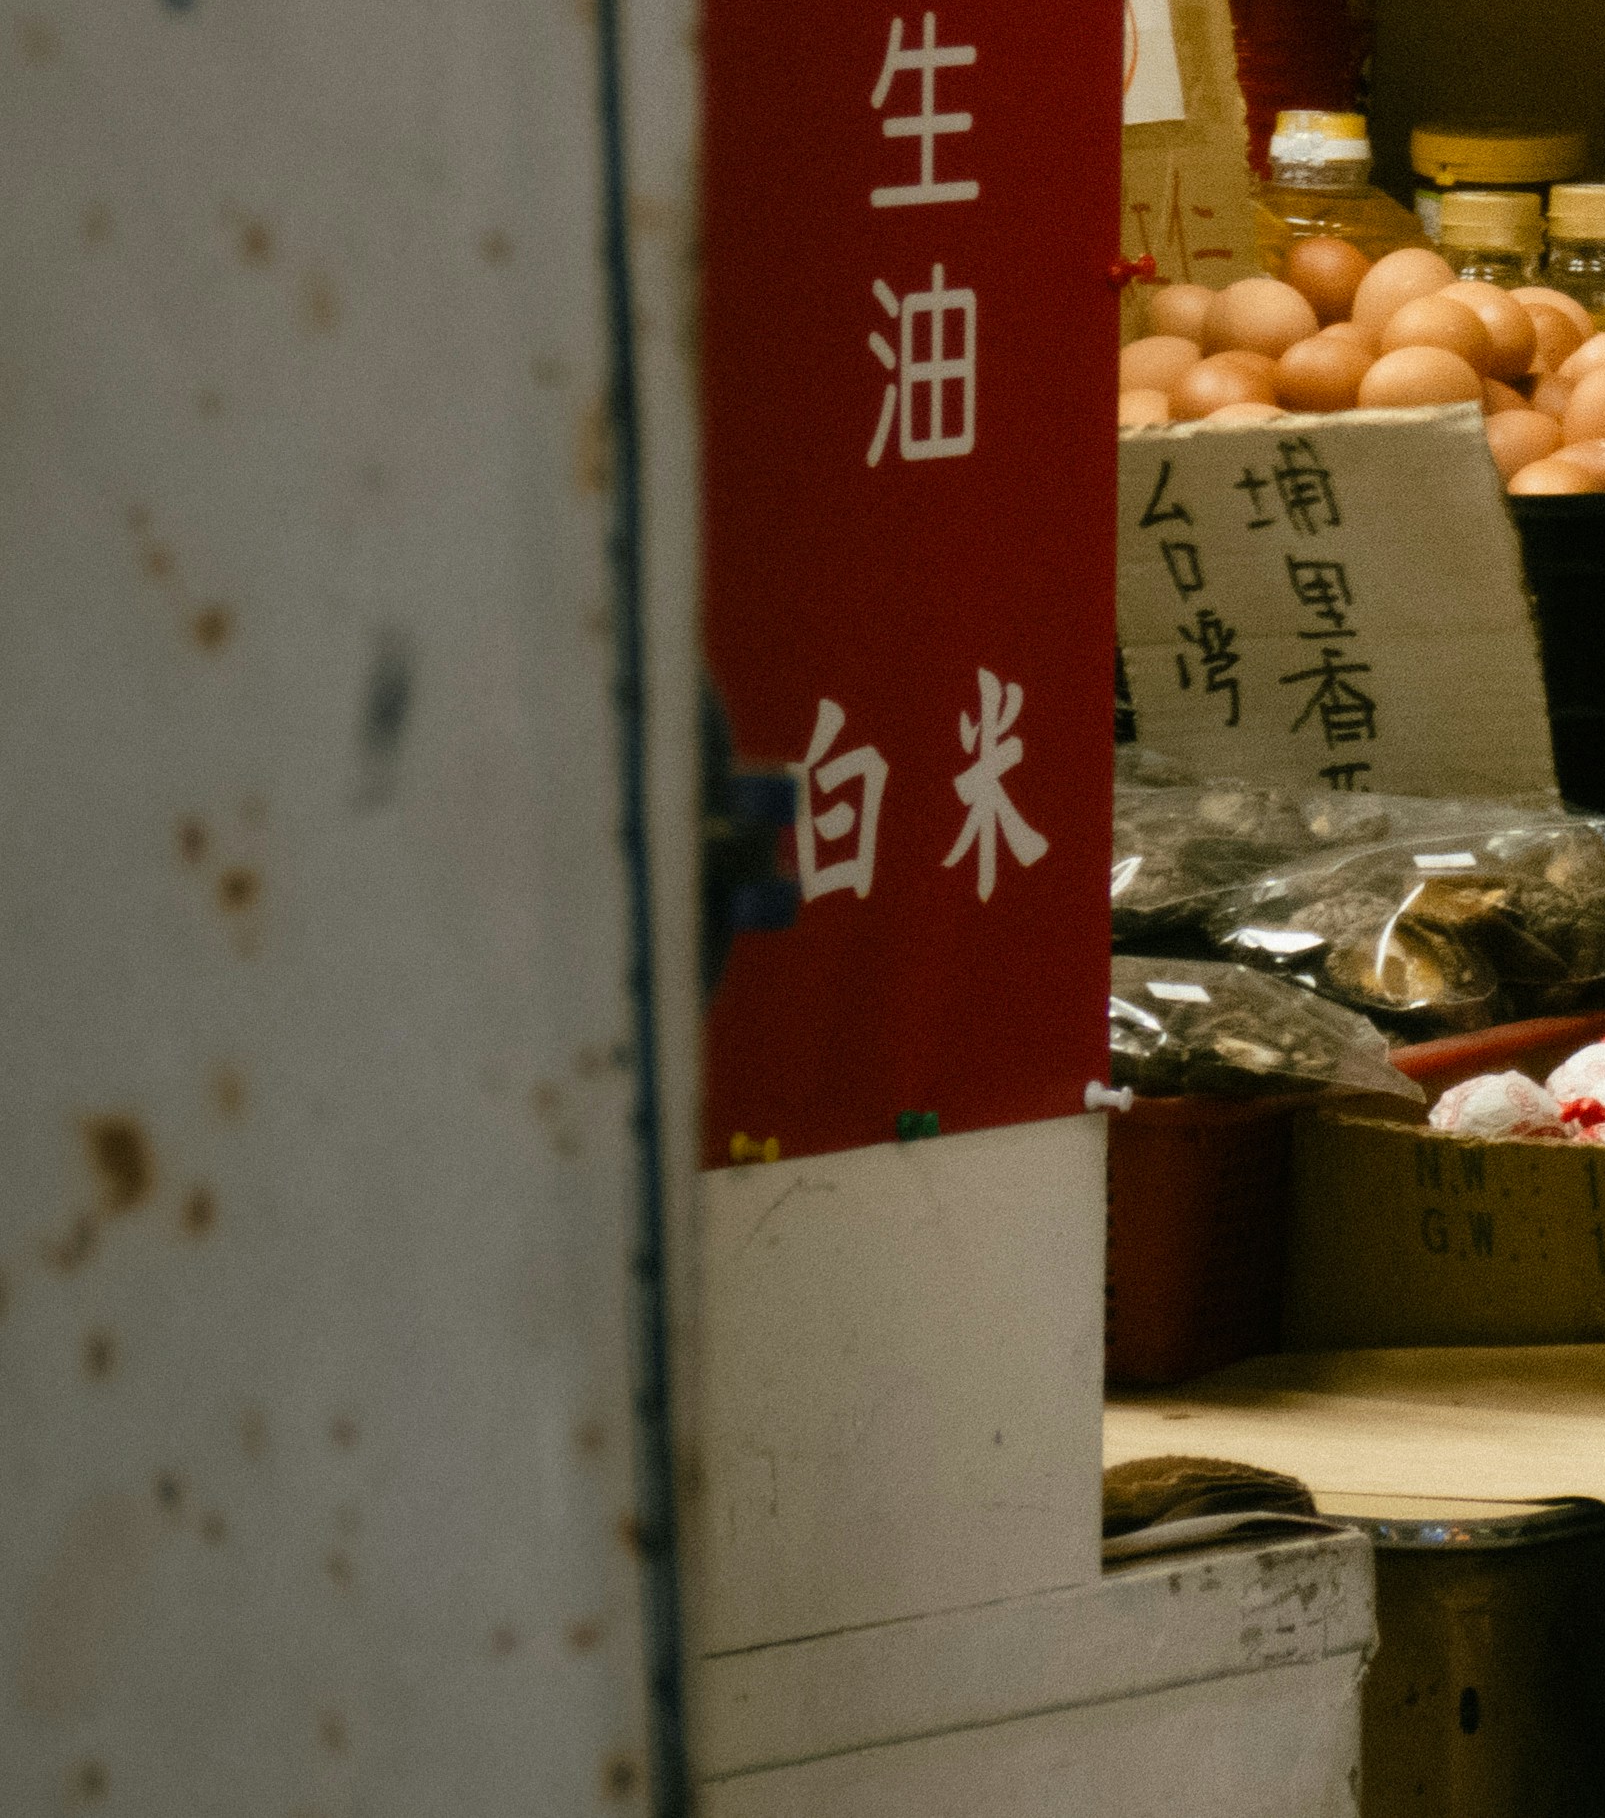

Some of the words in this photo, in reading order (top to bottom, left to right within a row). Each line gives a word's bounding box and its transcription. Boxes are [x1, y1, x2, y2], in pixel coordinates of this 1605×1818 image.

[1234, 433, 1380, 793] 埔里香
[798, 667, 1053, 907] 白米
